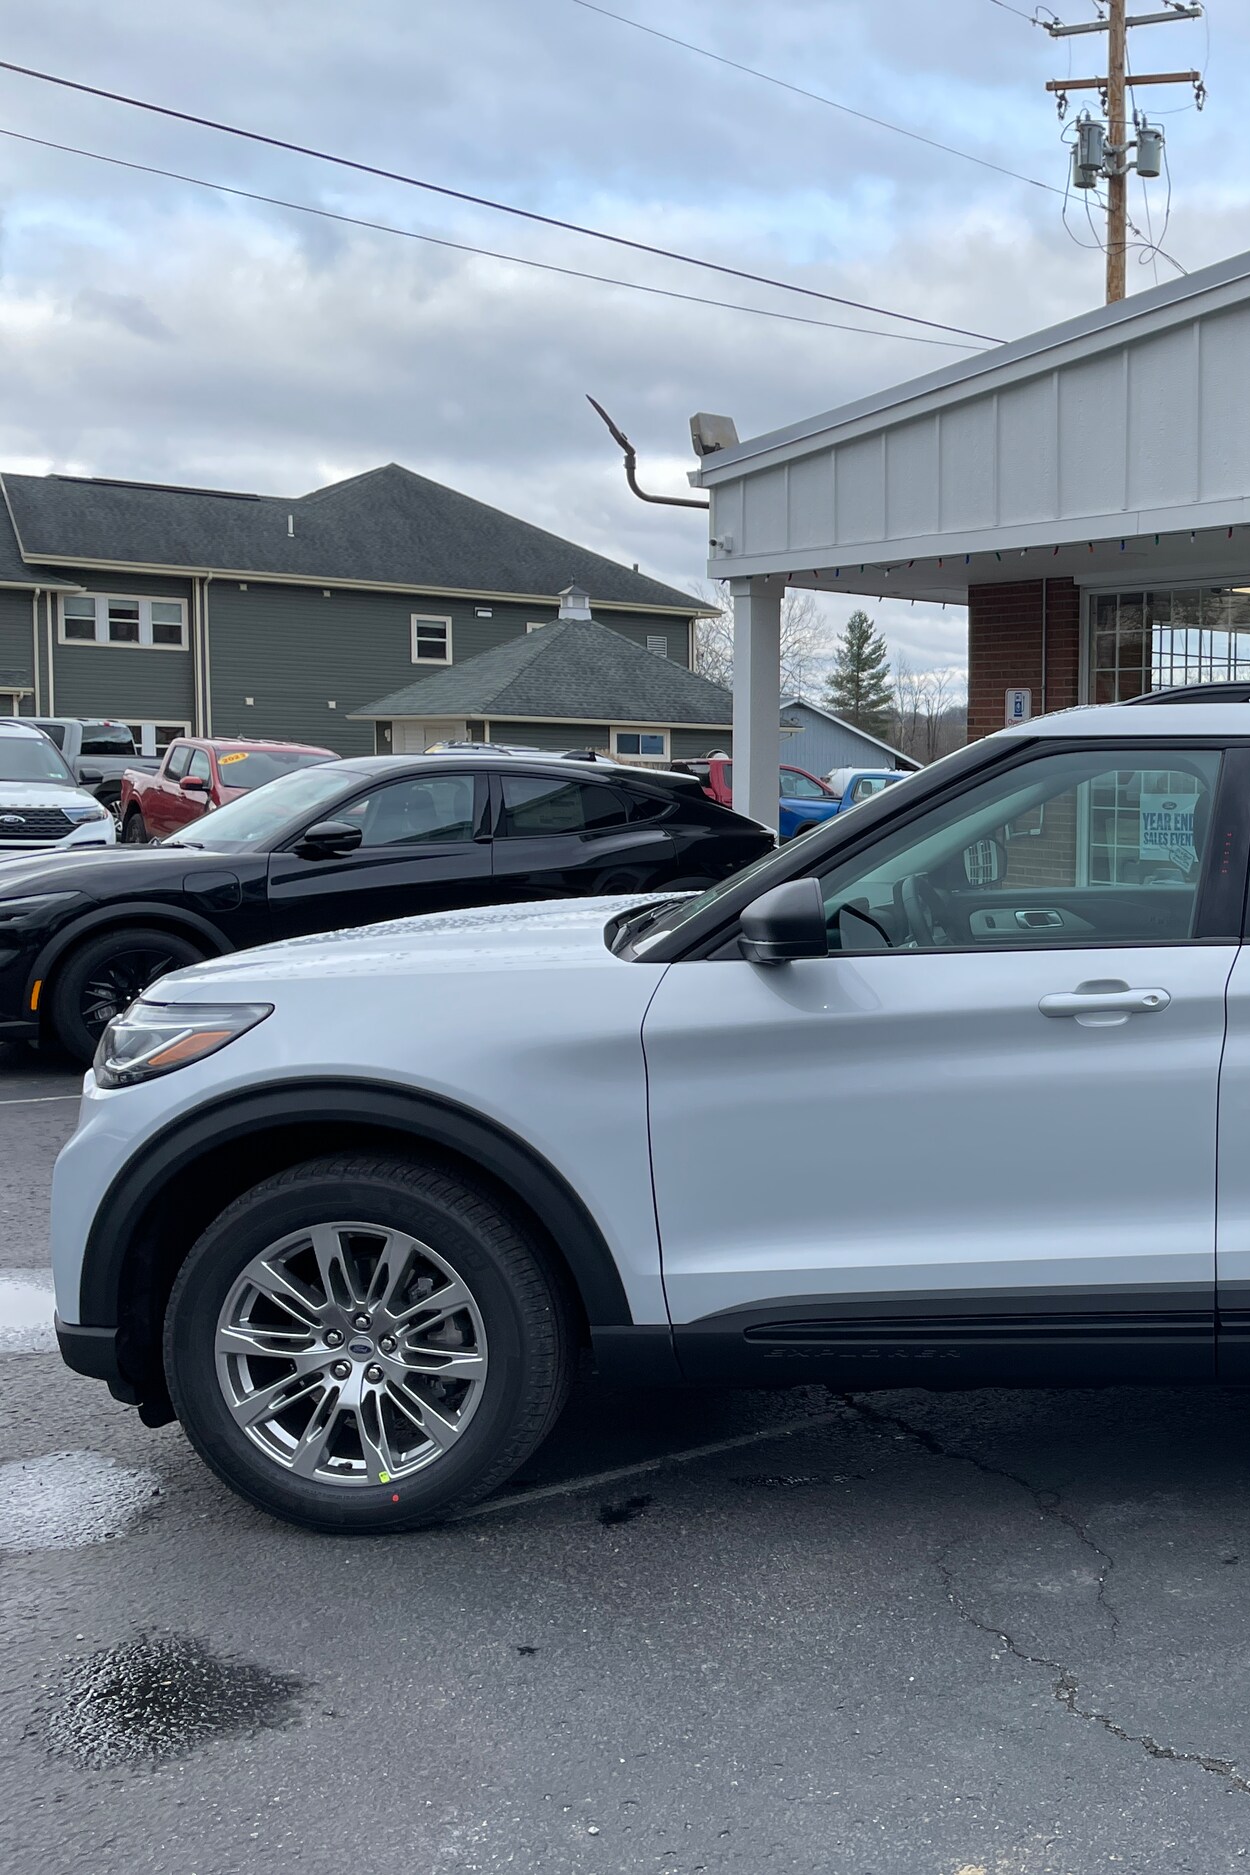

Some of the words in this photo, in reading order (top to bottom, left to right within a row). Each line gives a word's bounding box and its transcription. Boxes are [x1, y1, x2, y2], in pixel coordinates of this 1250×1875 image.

[1142, 812, 1171, 831] YEAR
[1143, 832, 1168, 846] SALES
[762, 1349, 961, 1359] EXPLORER
